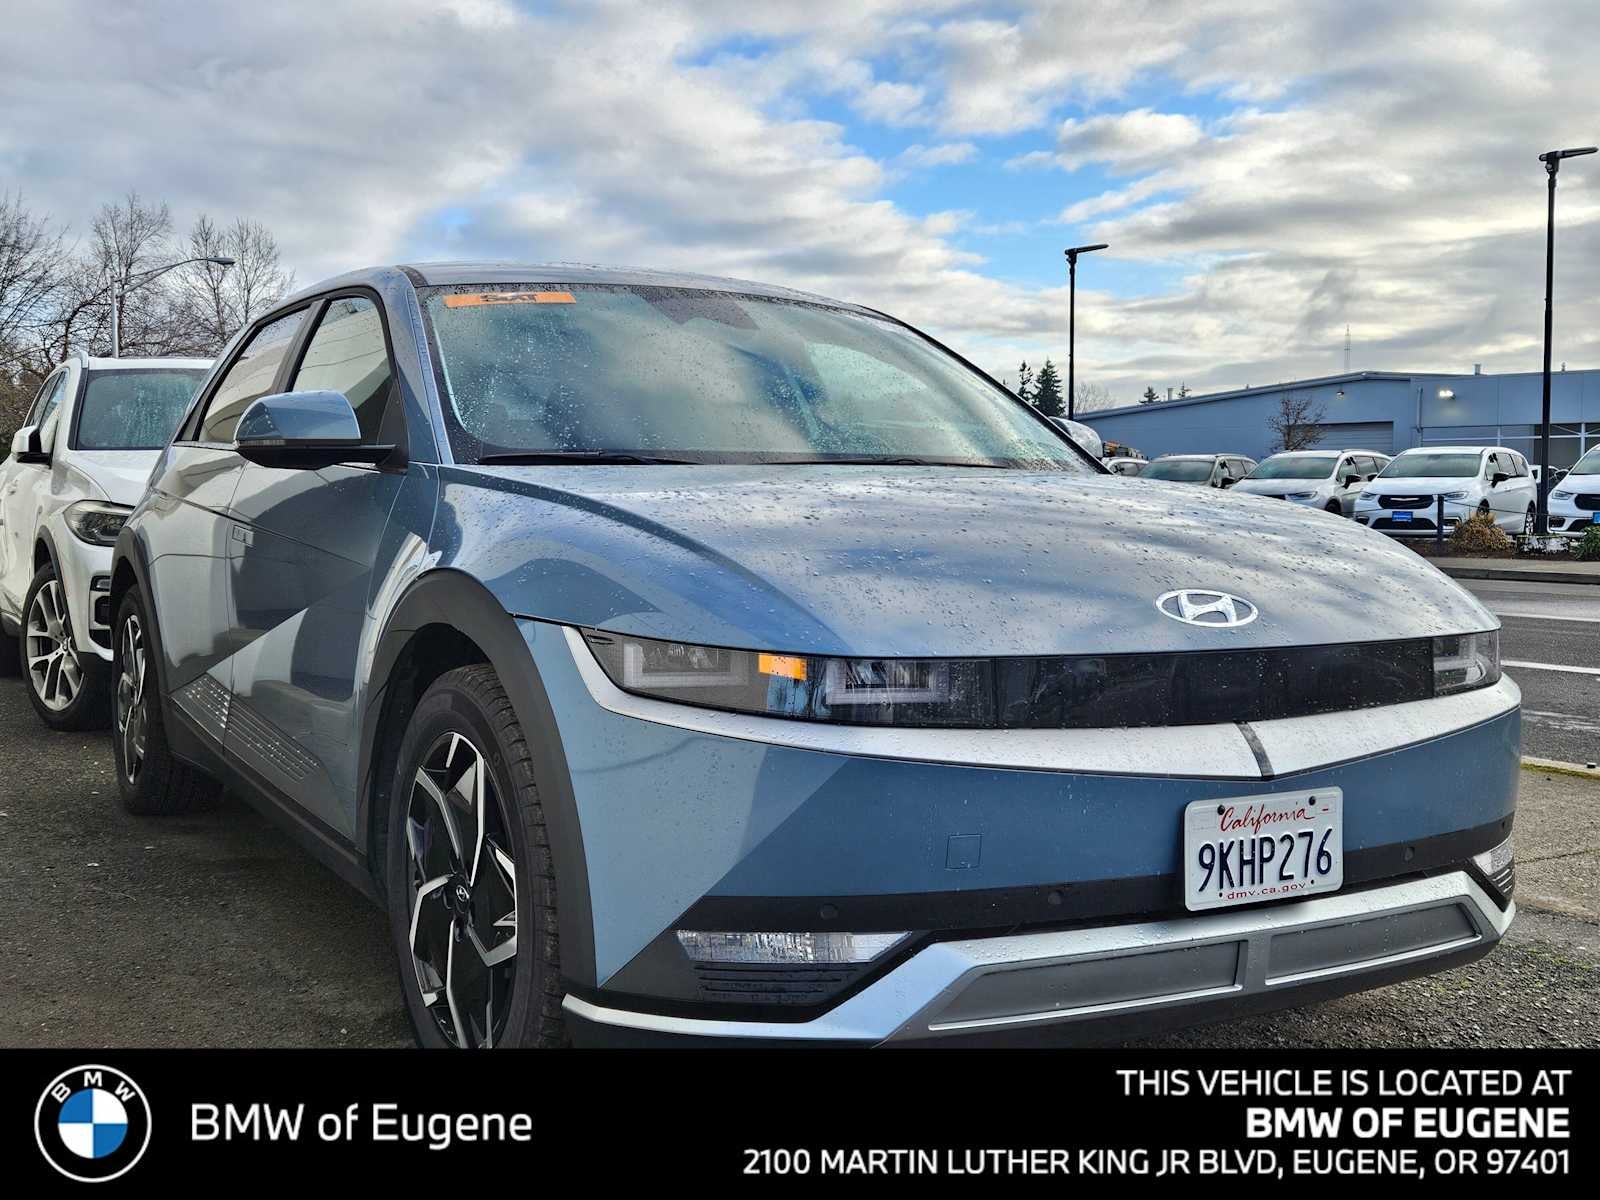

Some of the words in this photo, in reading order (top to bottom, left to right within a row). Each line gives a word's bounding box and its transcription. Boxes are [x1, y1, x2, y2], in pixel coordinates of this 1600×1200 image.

[1220, 804, 1315, 834] California
[1198, 828, 1332, 892] 9KHP276
[1227, 882, 1306, 899] dmv.ca.gov
